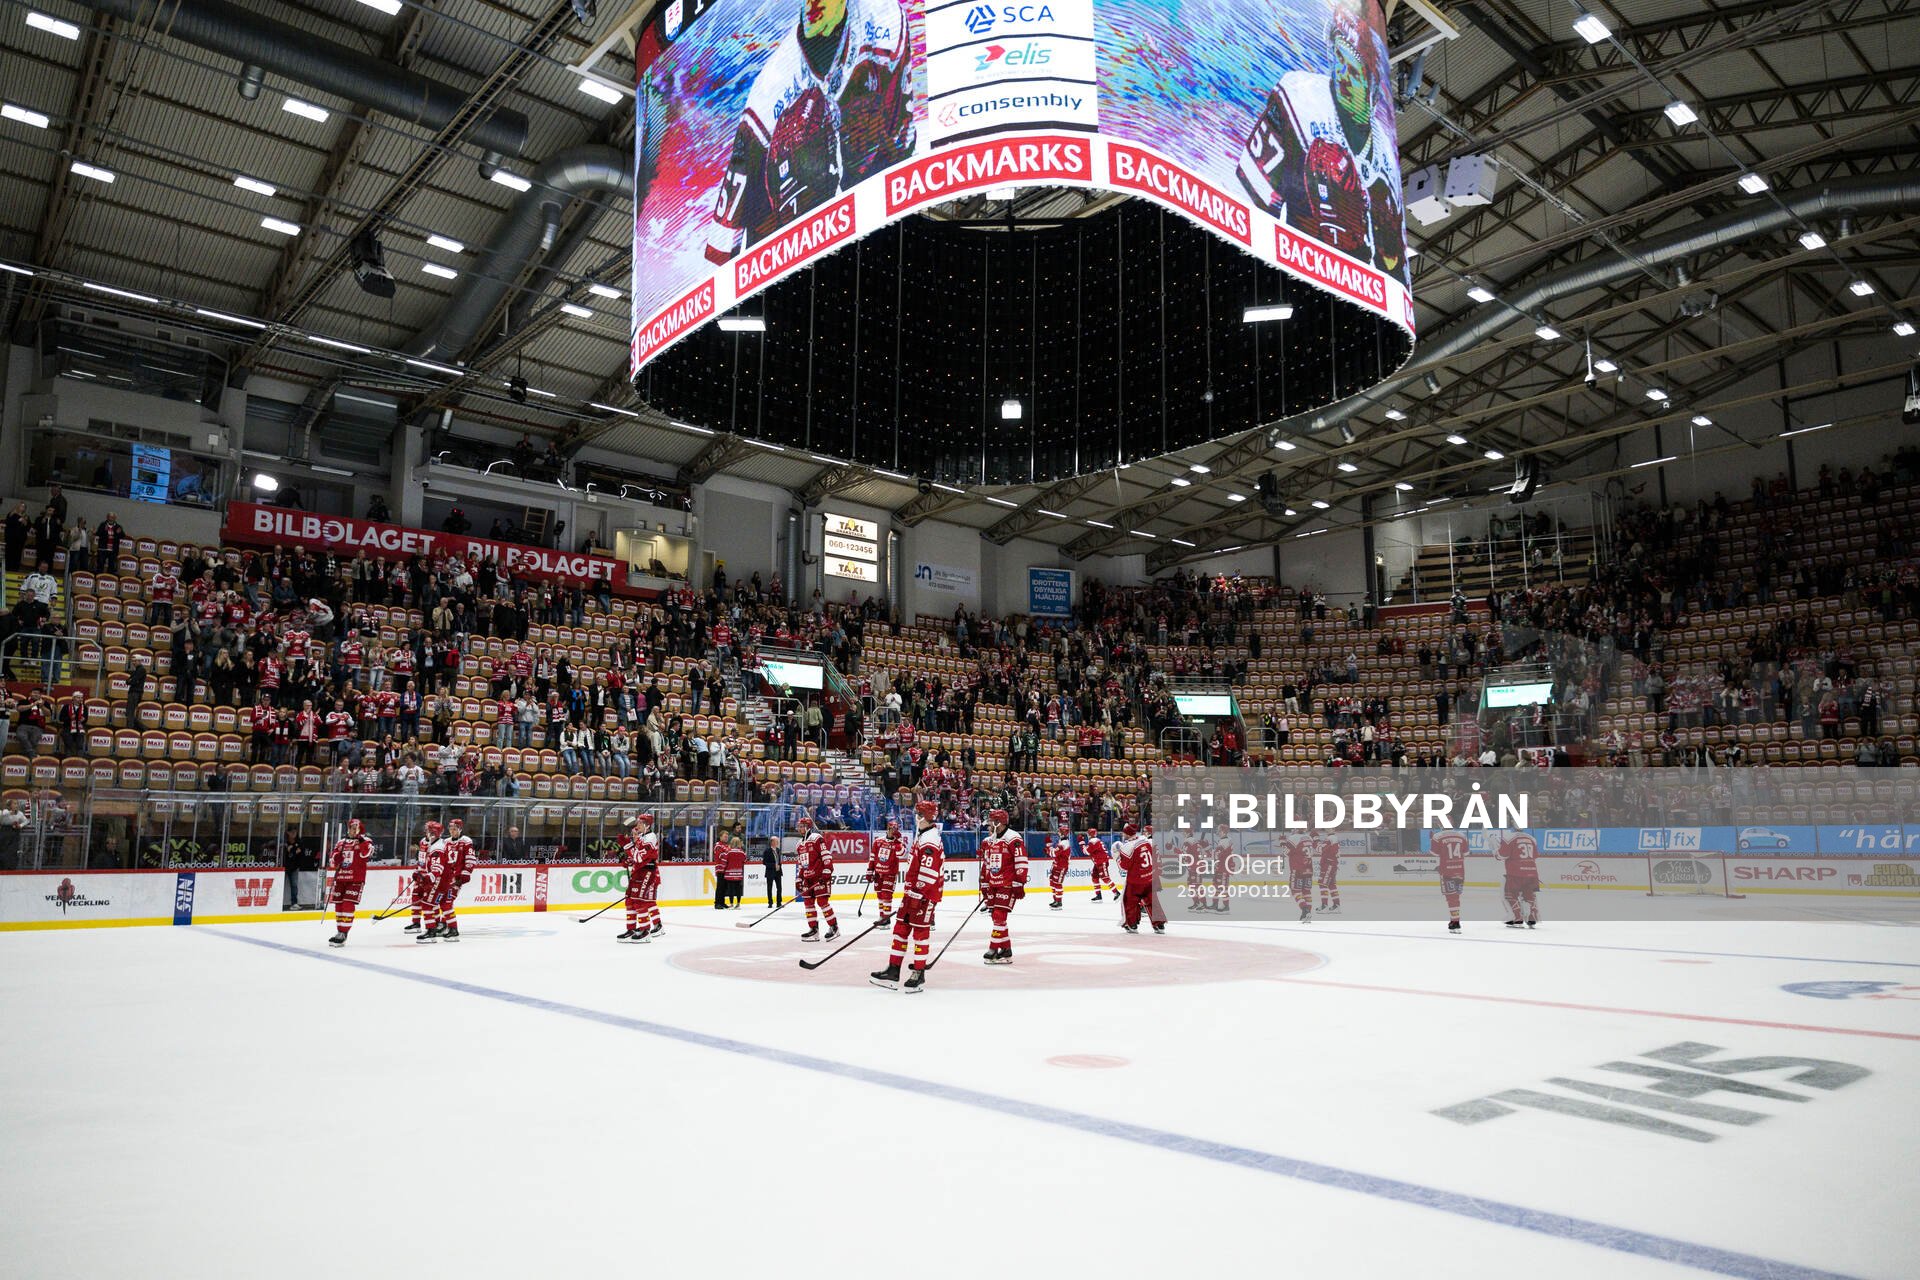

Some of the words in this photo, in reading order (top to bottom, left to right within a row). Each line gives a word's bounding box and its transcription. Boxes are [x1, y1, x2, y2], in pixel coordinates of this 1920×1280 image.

[1003, 6, 1054, 22] SCA
[1005, 42, 1052, 66] elis
[959, 93, 1082, 117] consembly
[891, 143, 1083, 207] BACKMARKS
[1116, 152, 1247, 236] BACKMARKS
[737, 204, 850, 288] BACKMARKS
[1279, 234, 1384, 303] BACKMARKS
[640, 287, 712, 357] BACKMARKS
[254, 510, 435, 555] BILBOLAGET
[839, 521, 864, 533] TAXI
[828, 540, 873, 554] 060-123456
[838, 564, 863, 575] TAXI
[830, 839, 864, 854] AVIS
[1674, 832, 1696, 846] fix
[1014, 847, 1023, 856] 31
[1446, 842, 1462, 859] 14
[921, 855, 933, 867] 28
[1560, 874, 1618, 882] PROLYMPIA
[1734, 866, 1838, 881] SHARP
